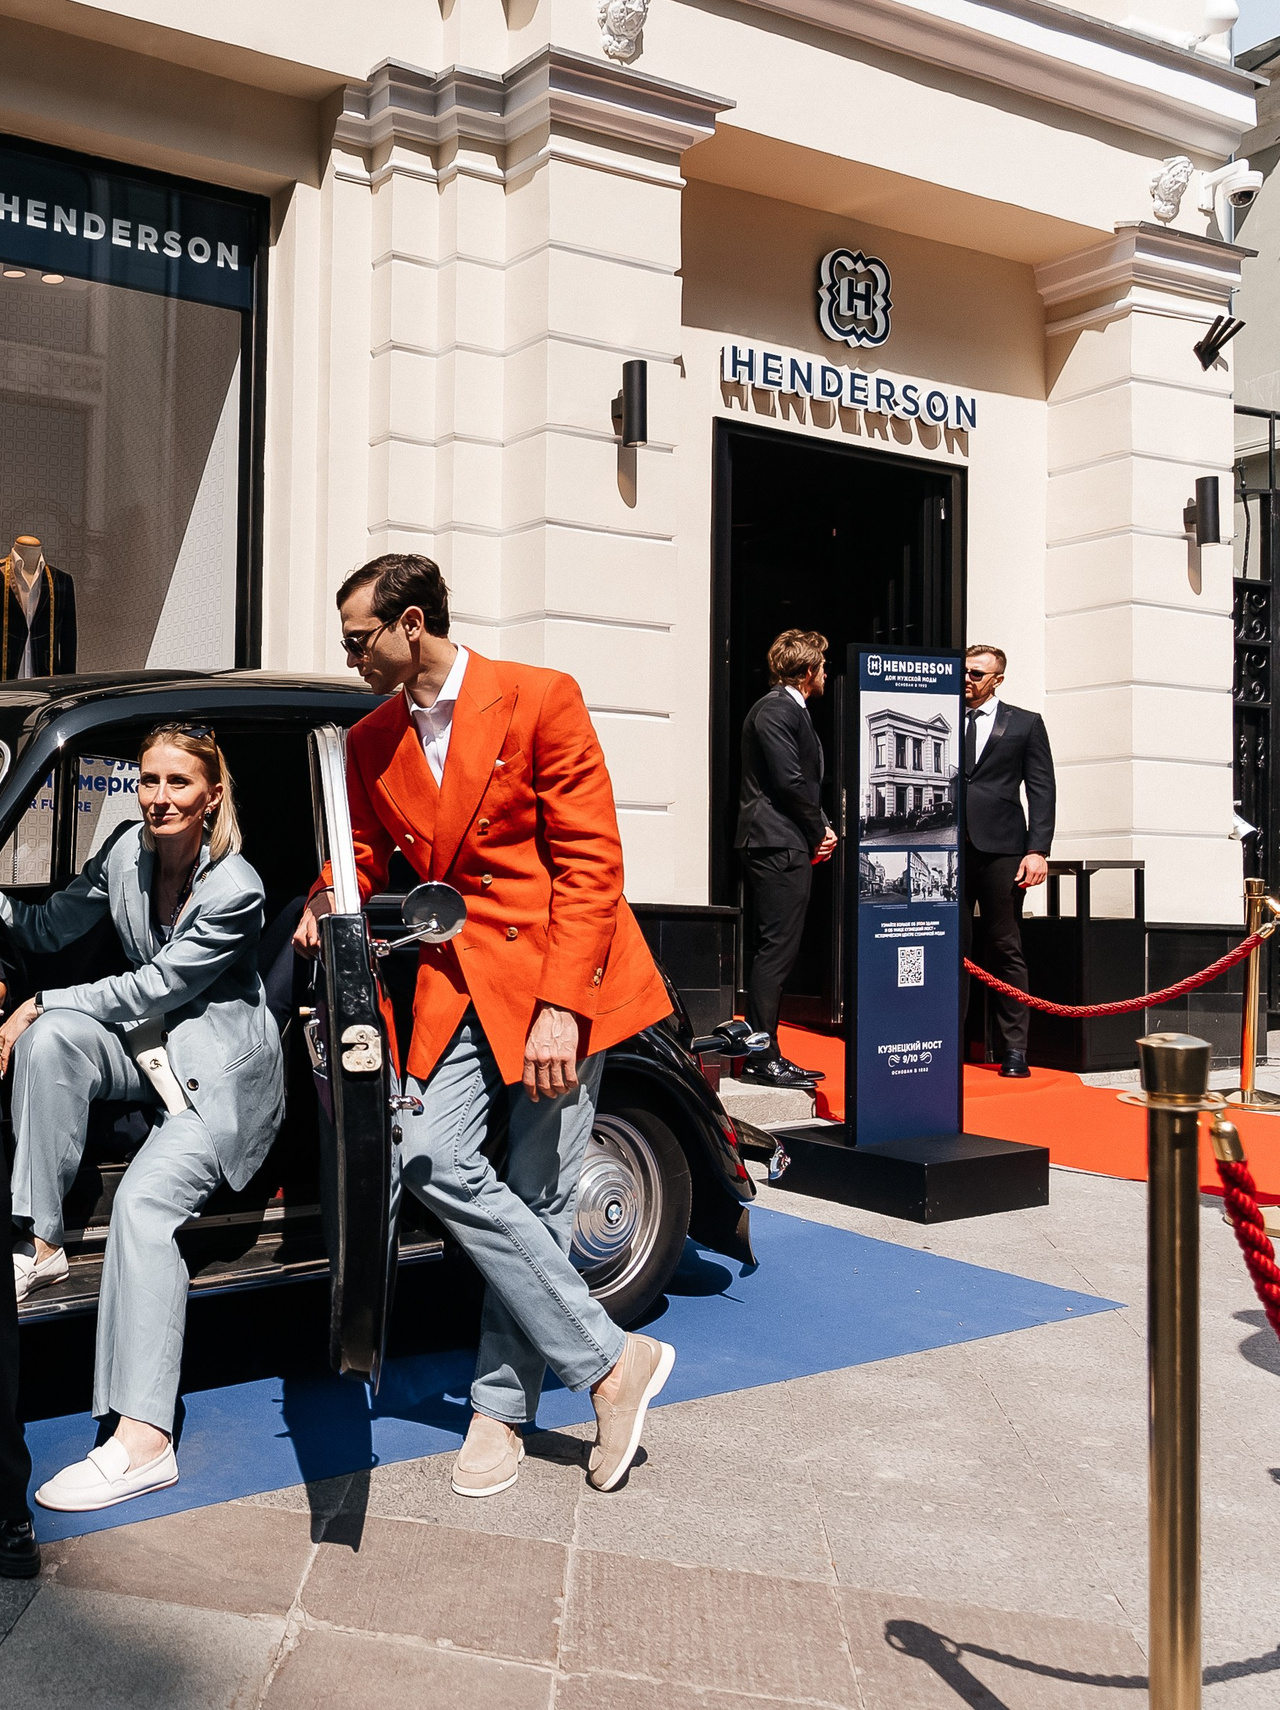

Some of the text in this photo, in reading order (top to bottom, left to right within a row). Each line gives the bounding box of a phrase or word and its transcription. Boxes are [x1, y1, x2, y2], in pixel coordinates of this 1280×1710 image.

[723, 345, 977, 431] HENDERSON
[883, 660, 953, 675] HENDERSON
[878, 1040, 943, 1054] КУЗНЕЦКИЙ МОСТ
[902, 1054, 918, 1064] 9/10
